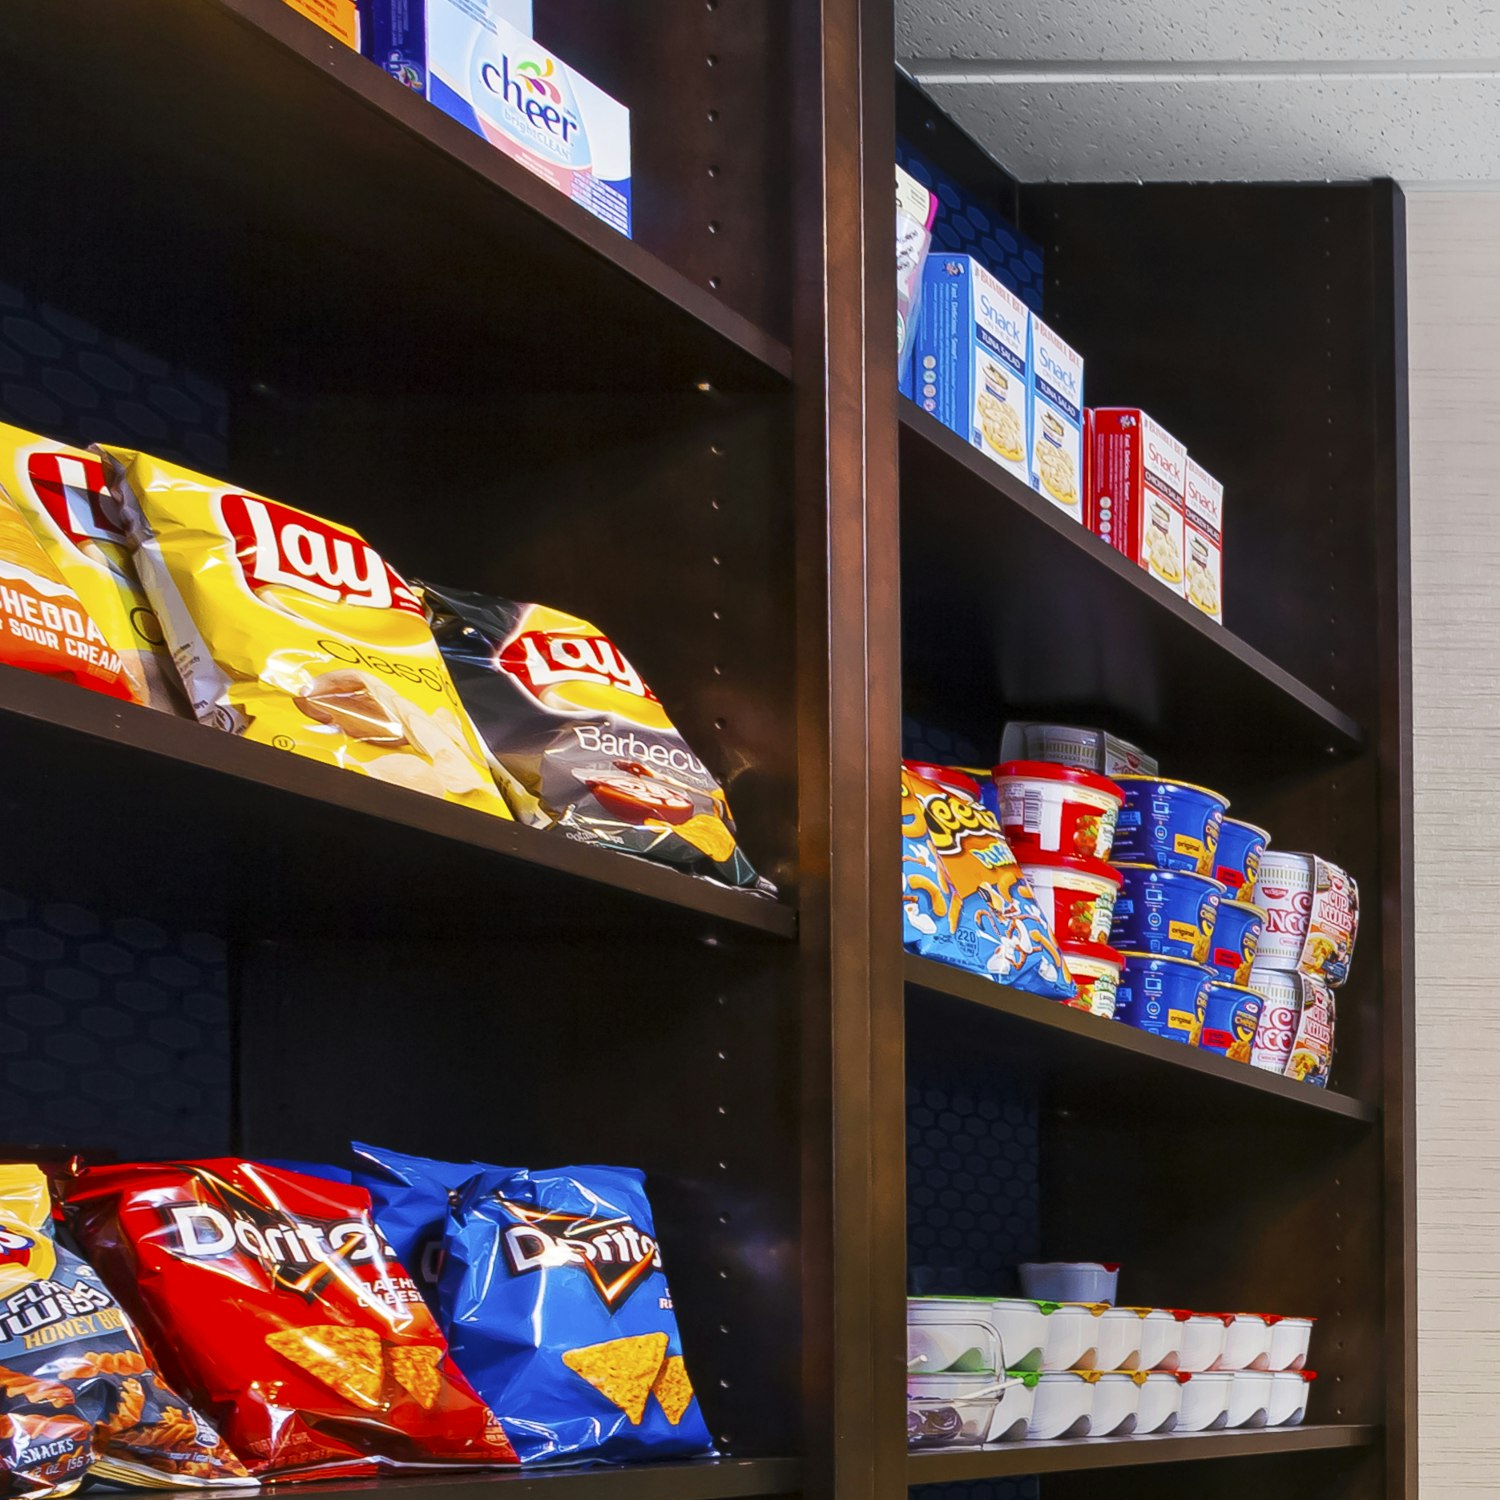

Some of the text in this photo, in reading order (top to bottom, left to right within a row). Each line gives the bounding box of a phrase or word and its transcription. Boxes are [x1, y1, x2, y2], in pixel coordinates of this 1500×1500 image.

[481, 53, 578, 143] cheer
[980, 293, 1022, 342] Snack
[1038, 346, 1077, 393] Snack
[1148, 440, 1181, 482] Snack
[1187, 478, 1218, 520] Snack
[11, 616, 123, 675] SOUR CREAM
[573, 724, 709, 775] Barbecu
[23, 1314, 100, 1351] HONEY
[22, 1438, 74, 1465] SNACKS
